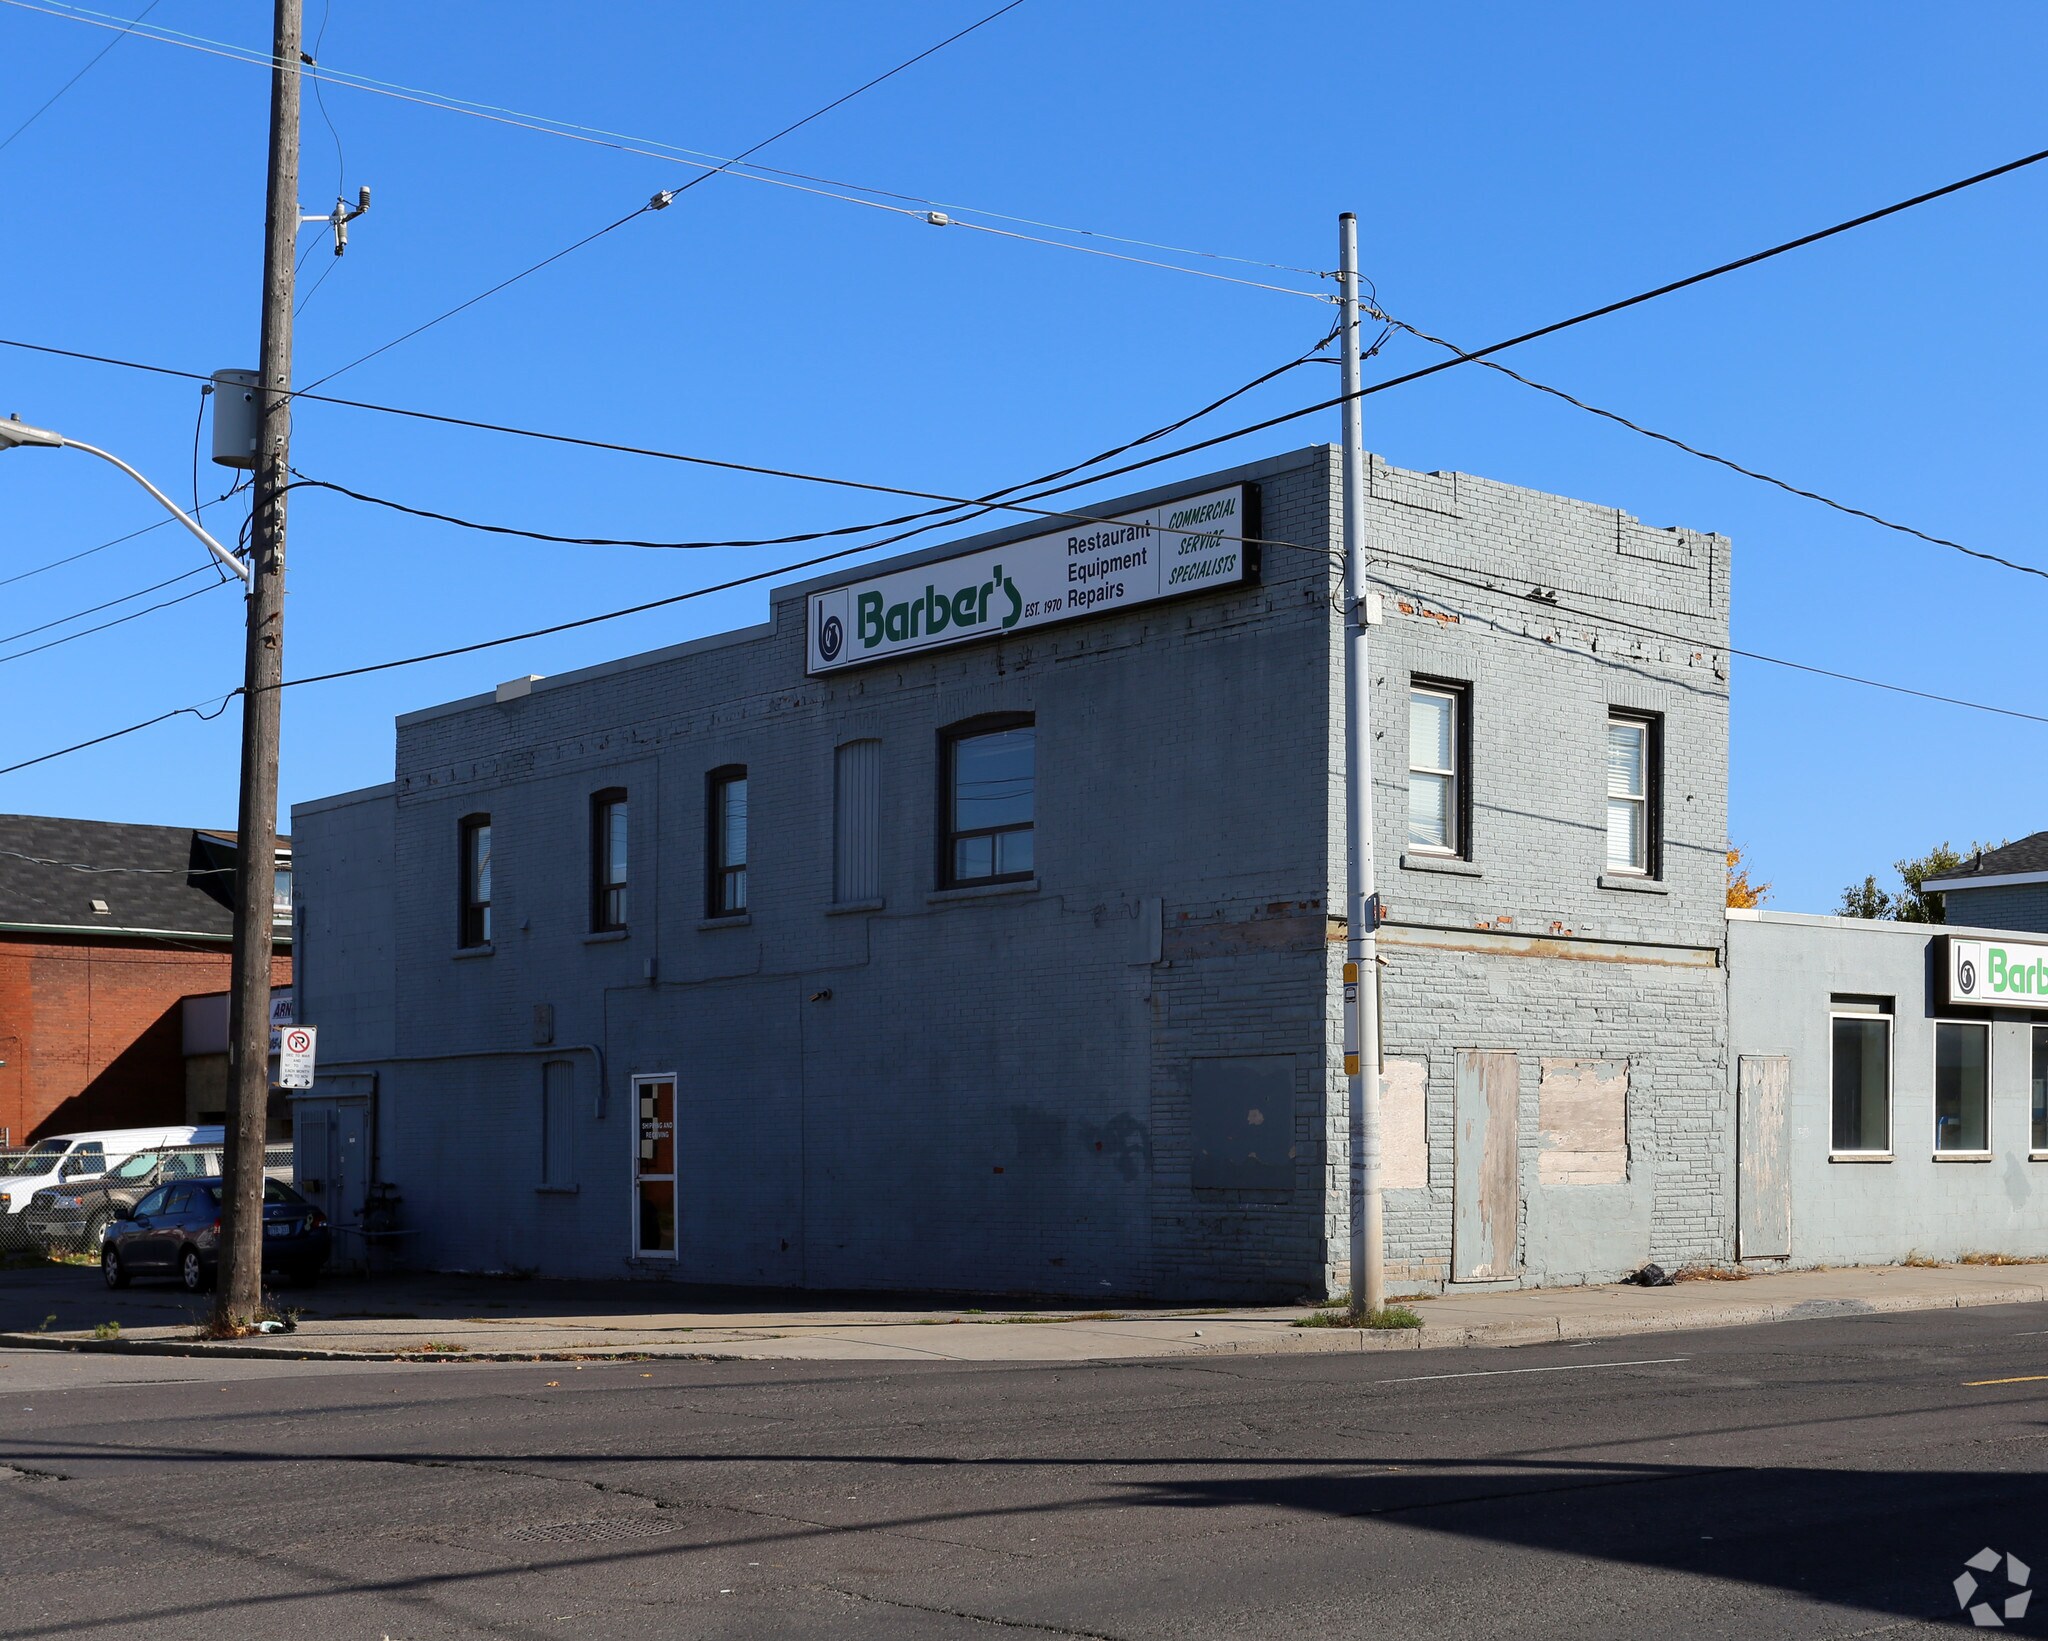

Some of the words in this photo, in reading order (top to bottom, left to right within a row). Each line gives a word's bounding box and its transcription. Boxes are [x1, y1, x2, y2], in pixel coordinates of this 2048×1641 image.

[1168, 497, 1236, 530] COMMERCIAL
[1067, 519, 1151, 556] Restaurant
[1177, 529, 1225, 556] SERVICE
[1068, 547, 1147, 584] Equipment
[1168, 553, 1237, 586] SPECIALISTS
[857, 564, 1023, 649] Barber's
[1024, 601, 1040, 618] EST.
[1043, 598, 1063, 614] 1970
[1067, 581, 1125, 609] Repairs
